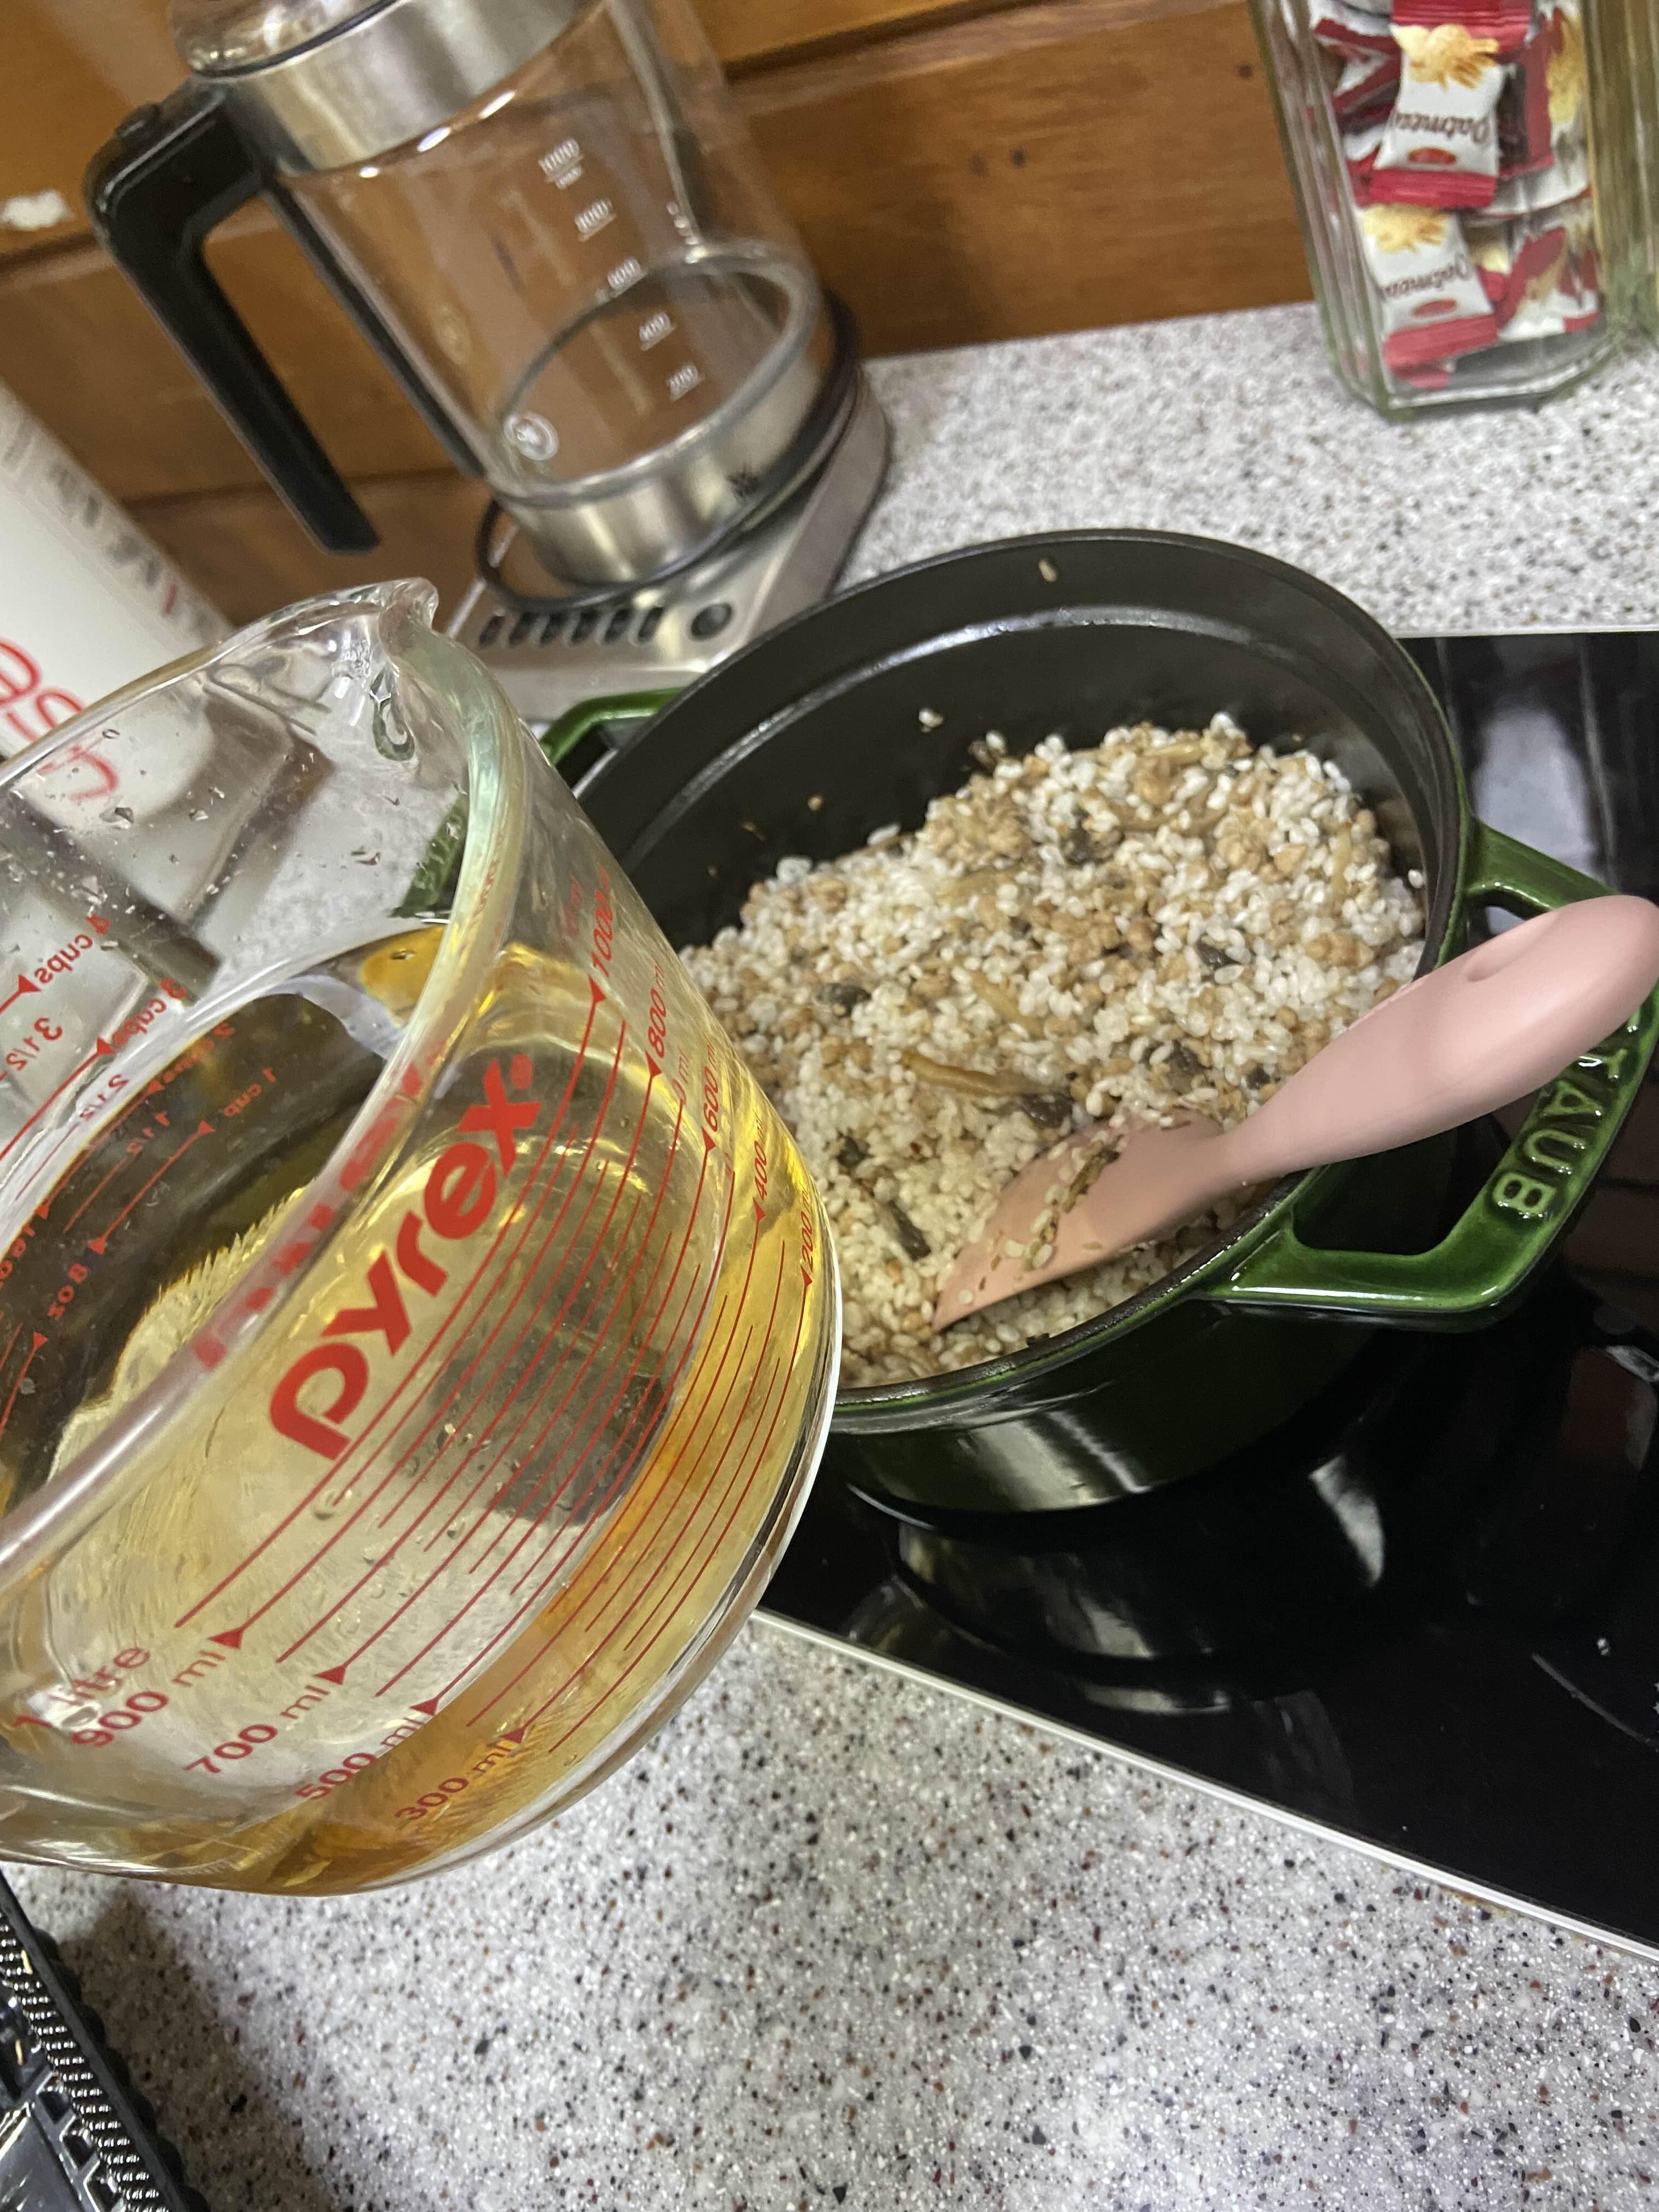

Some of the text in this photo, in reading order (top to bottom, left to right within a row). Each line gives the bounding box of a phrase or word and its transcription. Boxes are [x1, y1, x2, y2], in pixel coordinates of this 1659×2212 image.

[648, 986, 667, 1059] 800
[703, 1066, 719, 1132] 600
[1492, 1007, 1641, 1219] TAUB
[754, 1141, 768, 1201] 400
[270, 1054, 541, 1461] pyrex
[800, 1211, 814, 1273] 200
[70, 1650, 226, 1747] 900 ml
[183, 1684, 330, 1774] 700 ml
[295, 1717, 425, 1800] 500 ml
[393, 1741, 514, 1820] 300 ml
